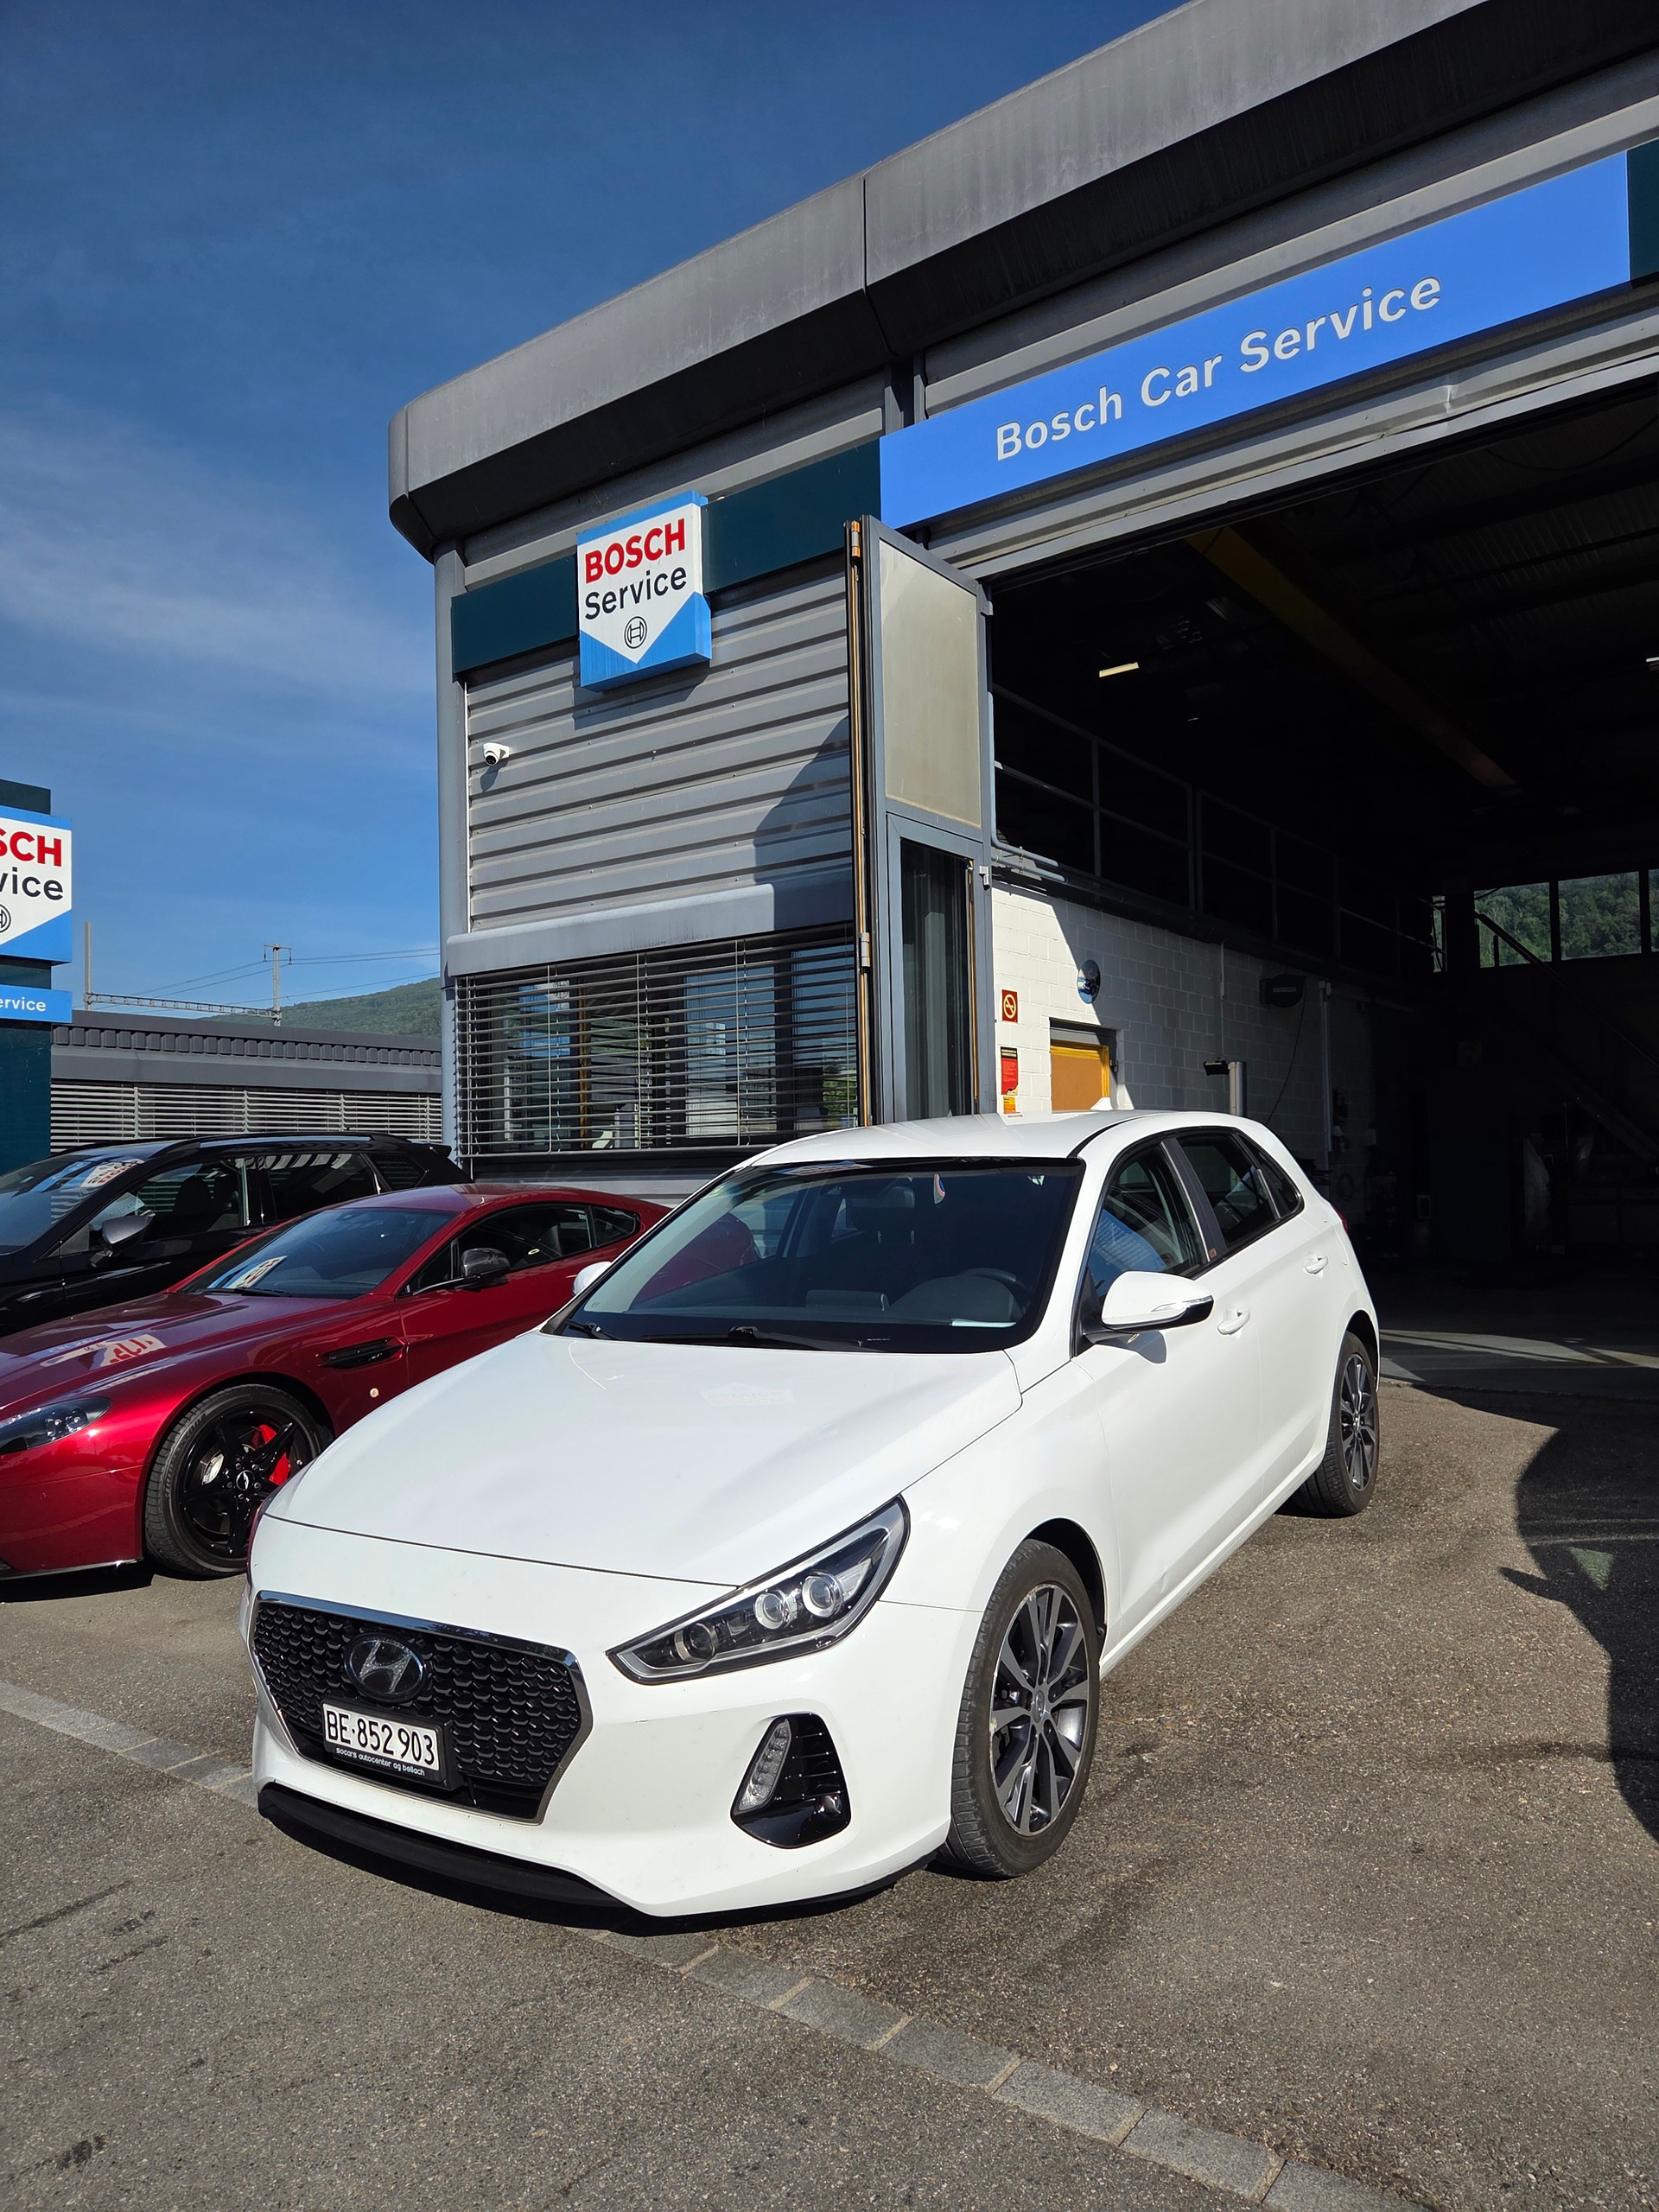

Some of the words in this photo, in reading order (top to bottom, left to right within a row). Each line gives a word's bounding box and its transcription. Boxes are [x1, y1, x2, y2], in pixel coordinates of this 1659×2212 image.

[997, 385, 1122, 461] Bosch
[1141, 354, 1223, 407] Car
[1239, 276, 1442, 372] Service
[585, 518, 685, 584] BOSCH
[585, 567, 687, 620] Service
[358, 1754, 391, 1767] autocenter
[402, 1764, 425, 1776] bellach
